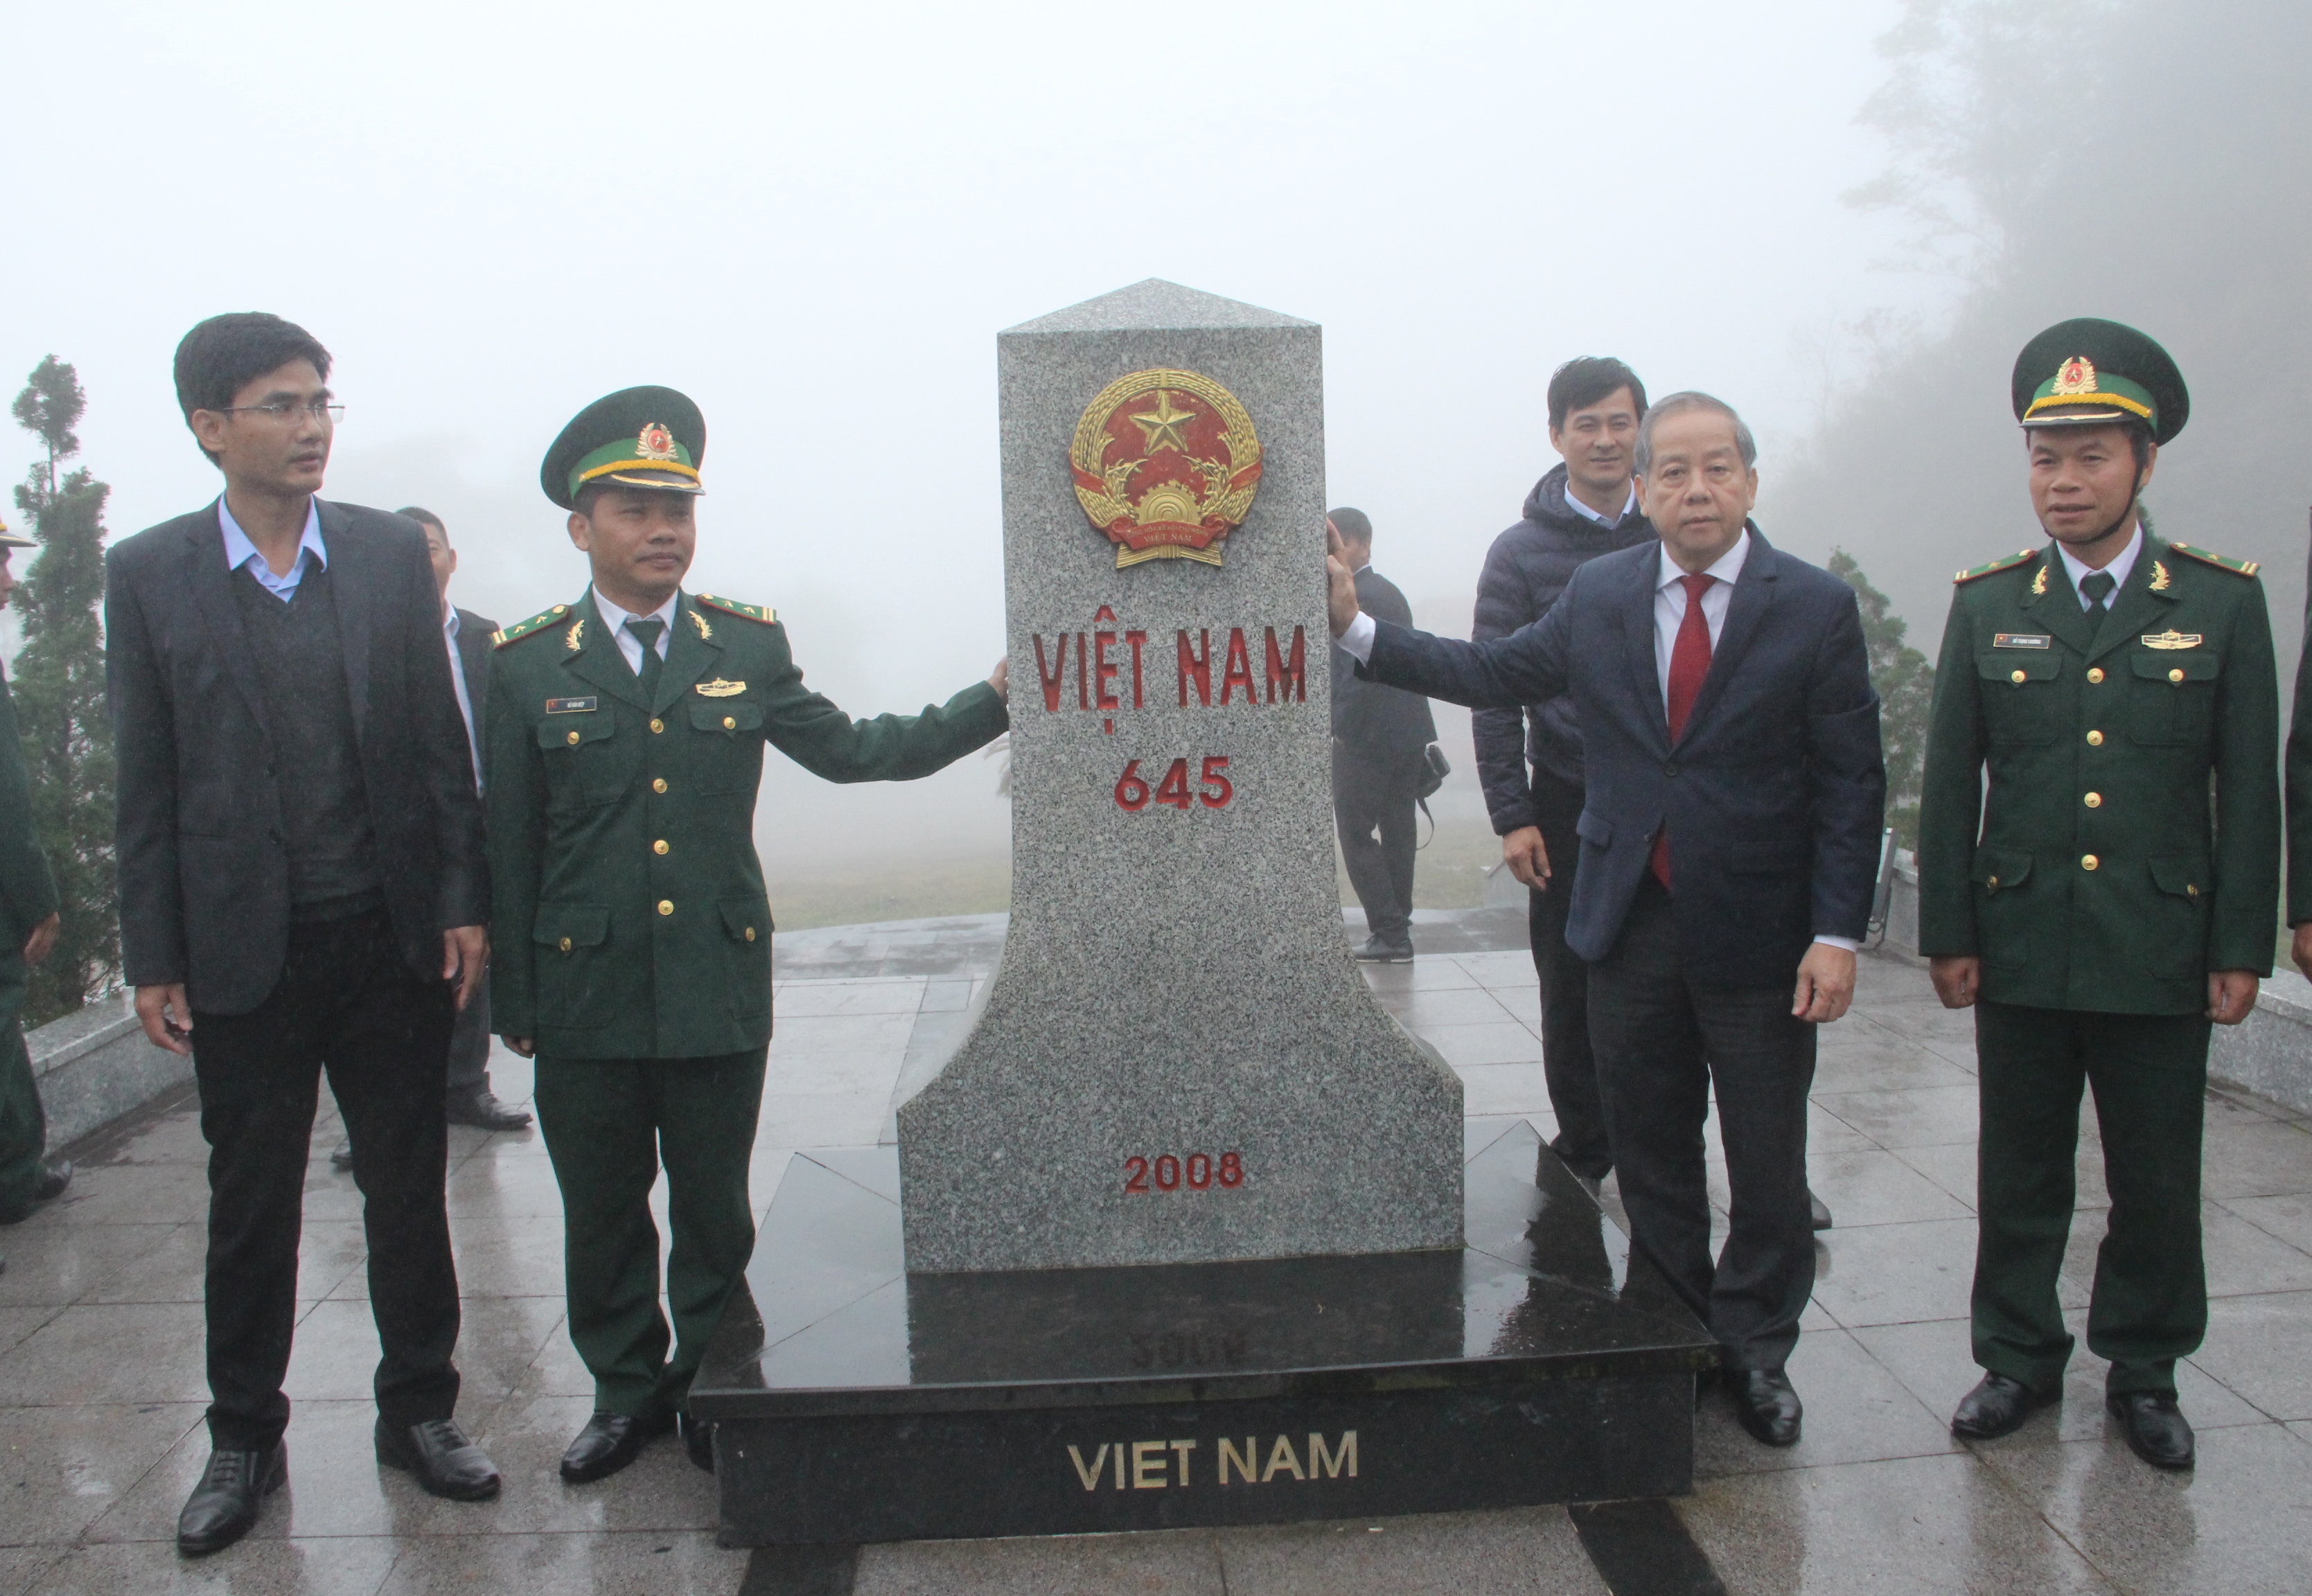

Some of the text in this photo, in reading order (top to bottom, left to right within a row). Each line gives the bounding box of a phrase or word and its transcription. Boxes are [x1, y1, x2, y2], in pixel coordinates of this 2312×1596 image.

[1171, 533, 1192, 542] NAM
[1032, 605, 1306, 734] VIỆT NAM
[1114, 756, 1232, 812] 645
[1124, 1151, 1243, 1194] 2008
[1067, 1430, 1357, 1491] VIET NAM
